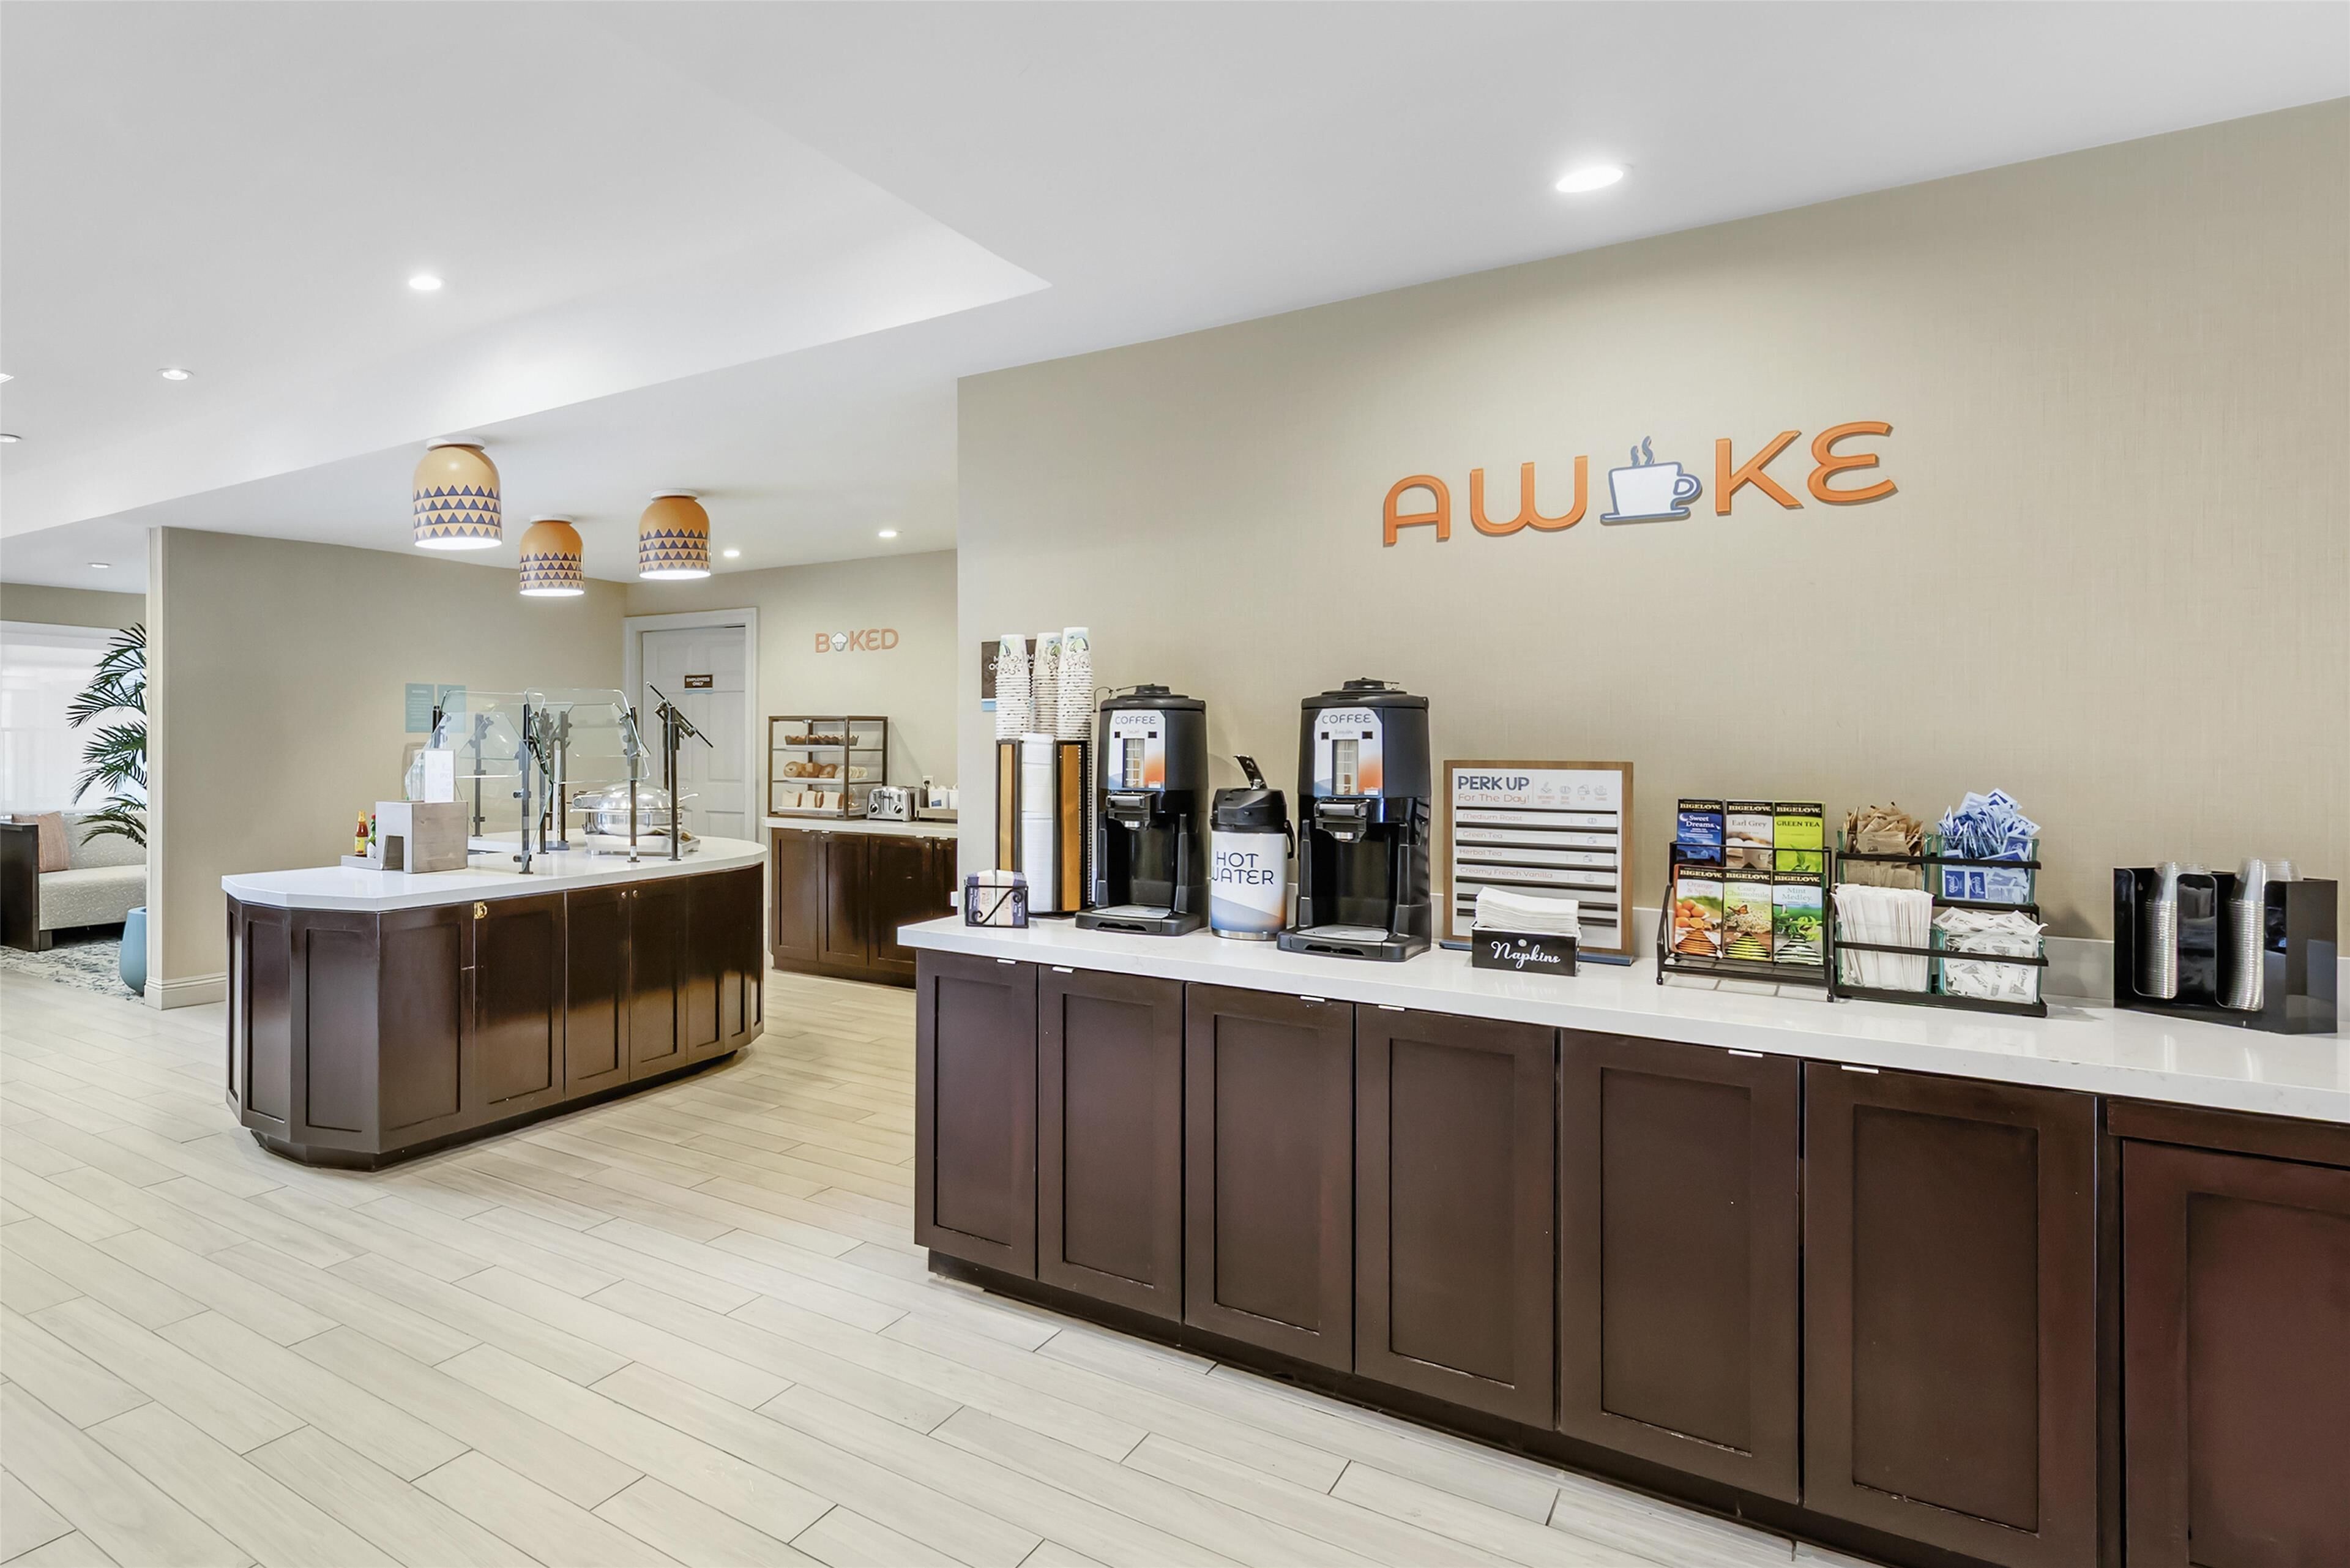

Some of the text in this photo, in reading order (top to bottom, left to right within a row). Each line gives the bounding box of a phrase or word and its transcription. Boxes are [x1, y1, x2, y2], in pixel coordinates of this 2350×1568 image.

[1115, 716, 1156, 725] COFFEE
[1322, 714, 1371, 724] COFFEE
[1458, 775, 1529, 791] PERK UP
[1458, 793, 1475, 802] For
[1479, 794, 1499, 802] The
[1504, 794, 1530, 804] Day!
[1215, 851, 1259, 868] HOT
[1460, 867, 1492, 876] Creamy
[1491, 941, 1561, 969] Napkins
